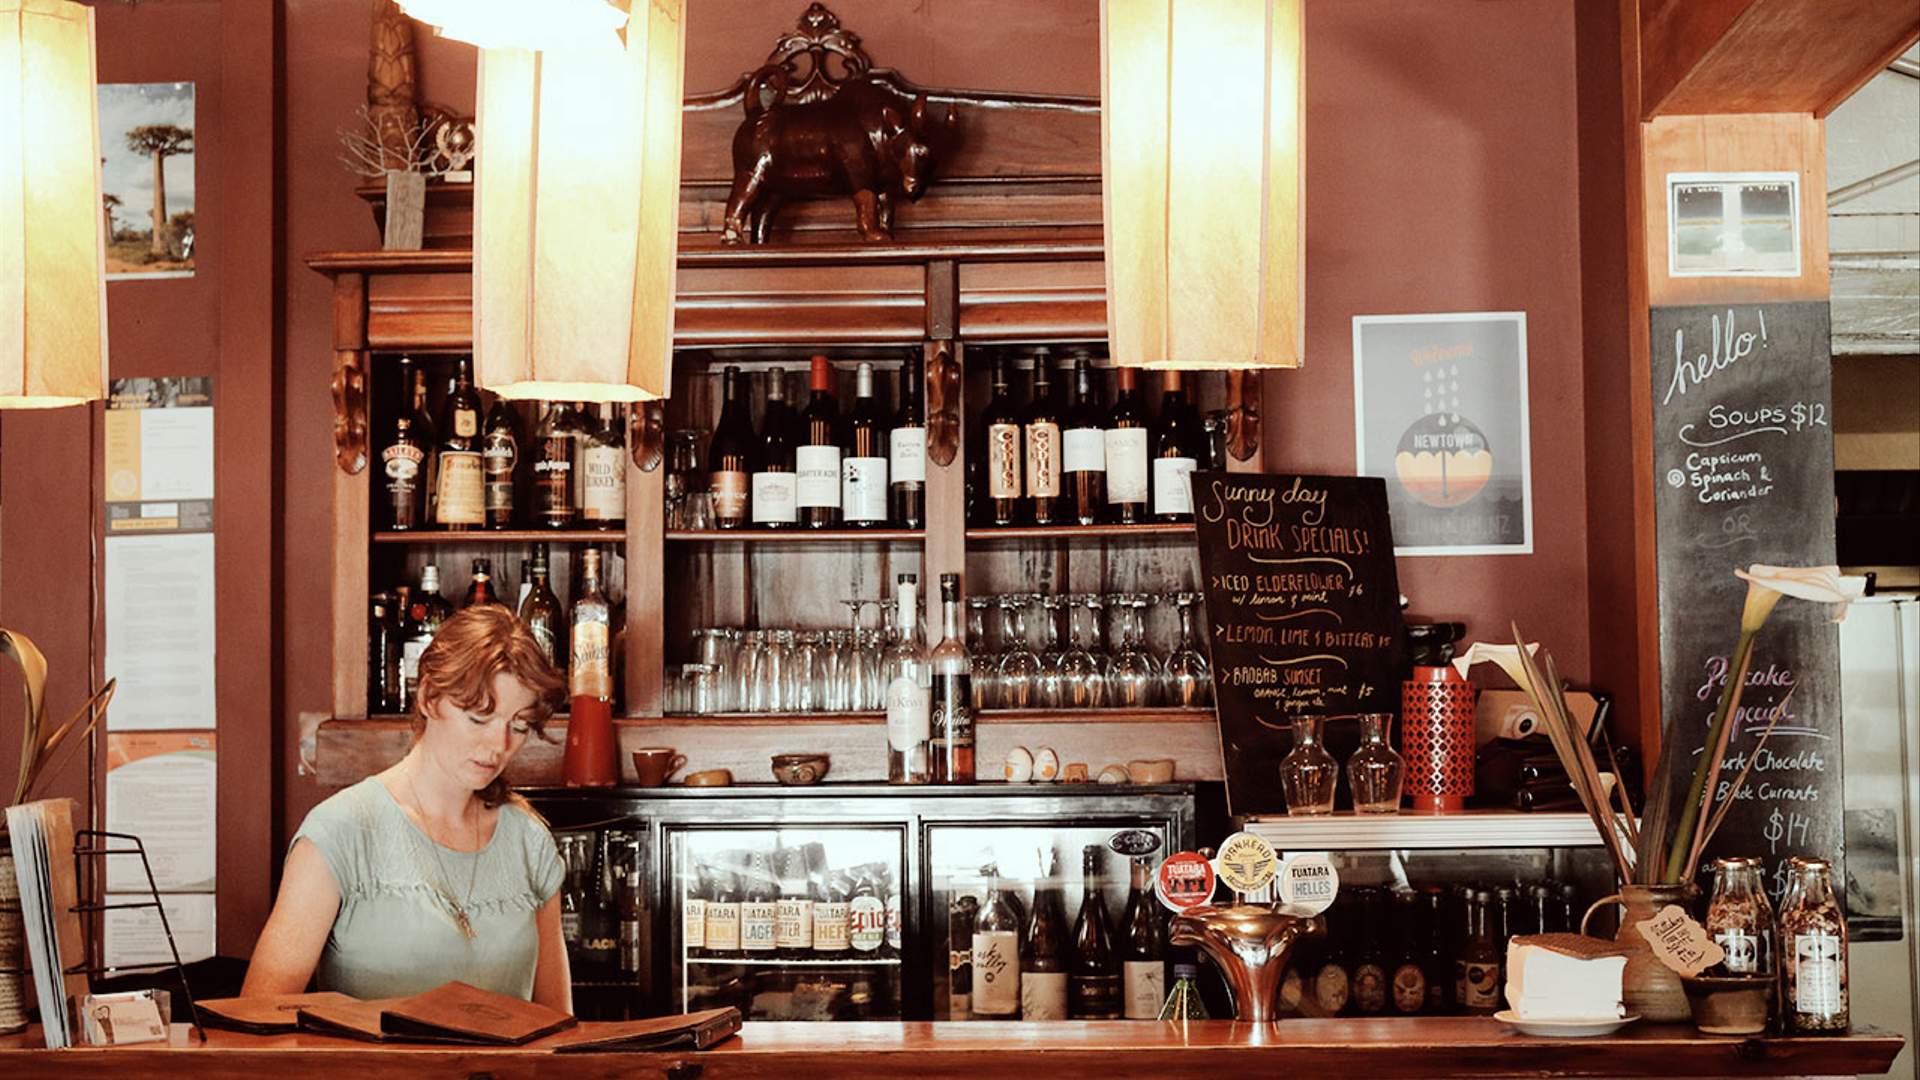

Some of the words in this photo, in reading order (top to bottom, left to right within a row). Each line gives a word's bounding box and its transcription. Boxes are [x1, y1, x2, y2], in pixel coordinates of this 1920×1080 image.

[1663, 309, 1768, 406] hello!
[1790, 402, 1827, 431] $12
[1413, 432, 1475, 449] NEWTOWN
[1686, 452, 1762, 472] Capsicum
[1690, 470, 1751, 491] Spinach
[1203, 480, 1275, 527] Sunny
[1282, 477, 1328, 525] day
[1698, 485, 1774, 503] Coriander
[1222, 574, 1249, 591] ICED
[1255, 573, 1345, 592] ELDERFLOWER
[1281, 628, 1310, 647] LIME
[1719, 751, 1746, 770] ark
[1754, 749, 1824, 772] Chocolate
[1758, 783, 1819, 801] Currants
[1763, 807, 1809, 855] $14
[1291, 866, 1331, 878] TUATARA
[1295, 881, 1332, 896] HELLES
